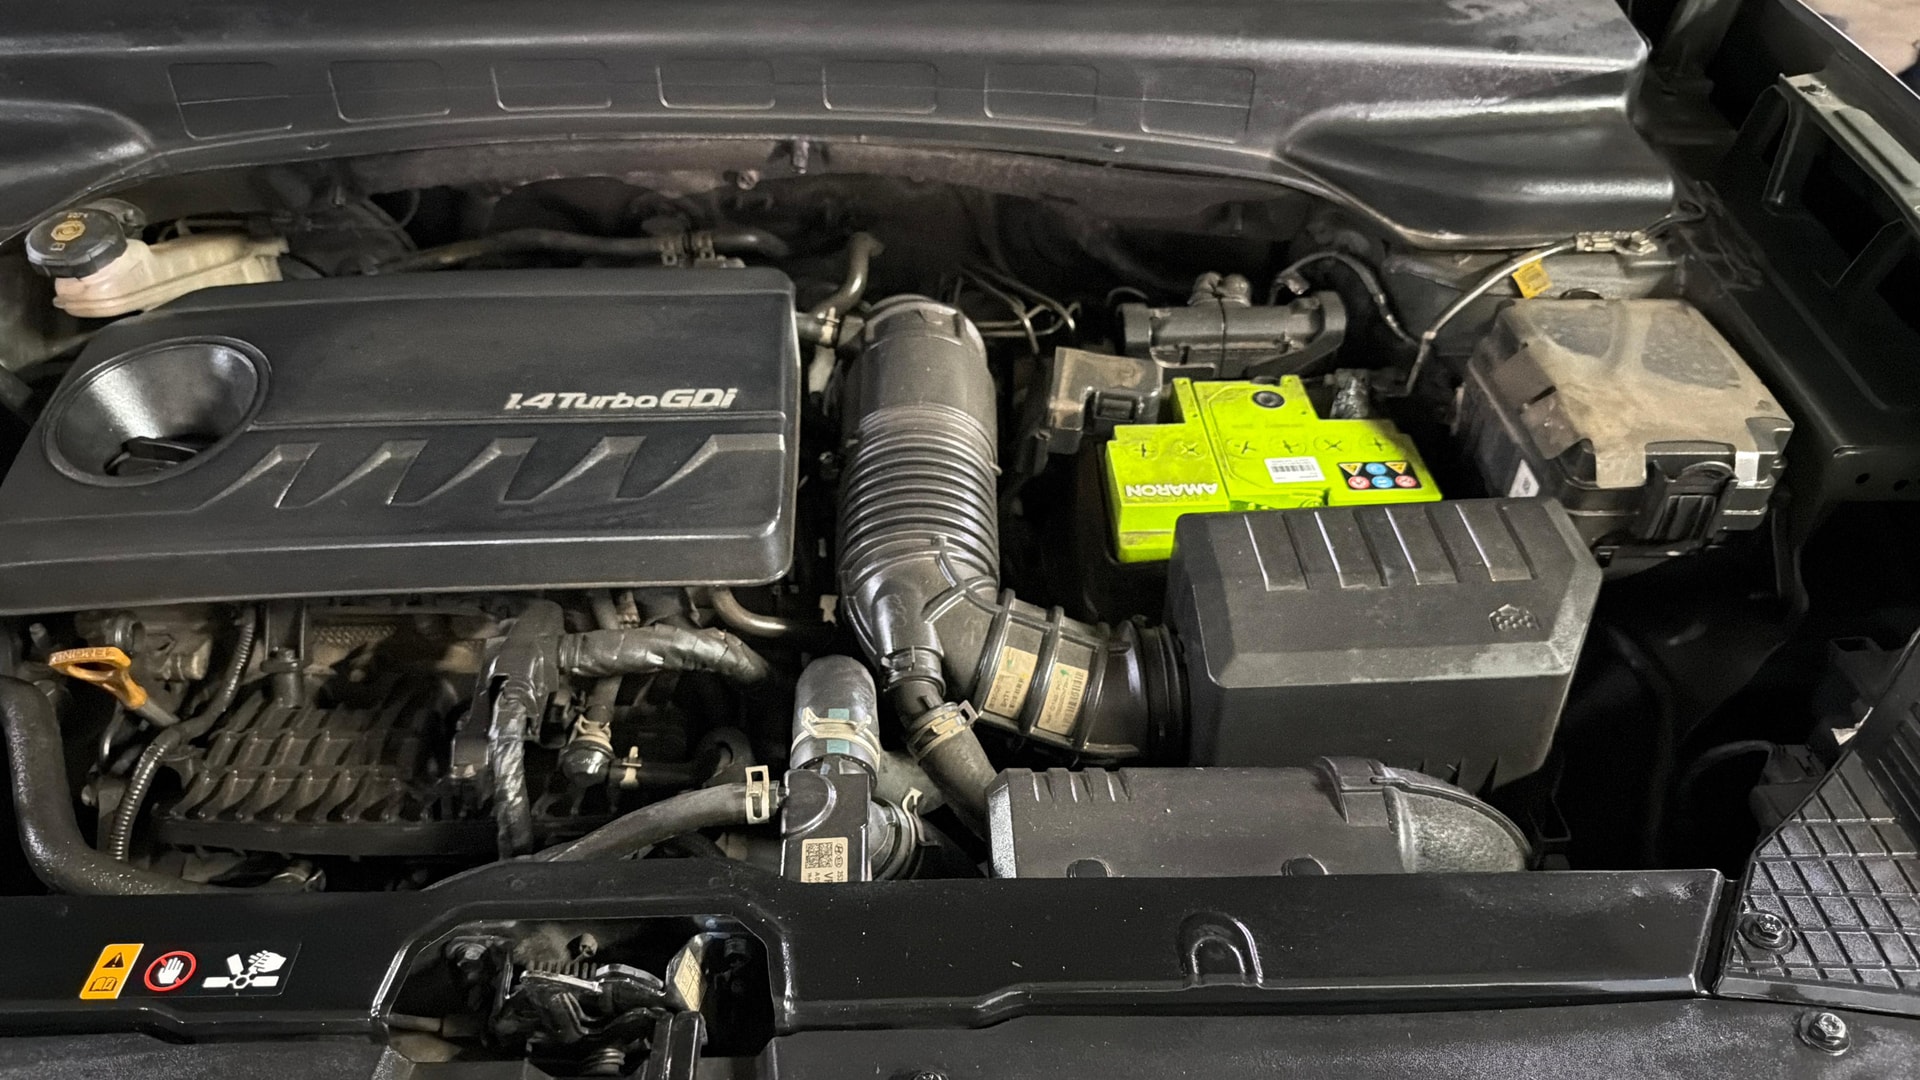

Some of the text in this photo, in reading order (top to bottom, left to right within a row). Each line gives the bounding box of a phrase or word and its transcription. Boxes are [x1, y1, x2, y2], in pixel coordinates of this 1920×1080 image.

[505, 388, 738, 410] 1.4 Turbo GDi
[1125, 482, 1219, 498] AMARON
